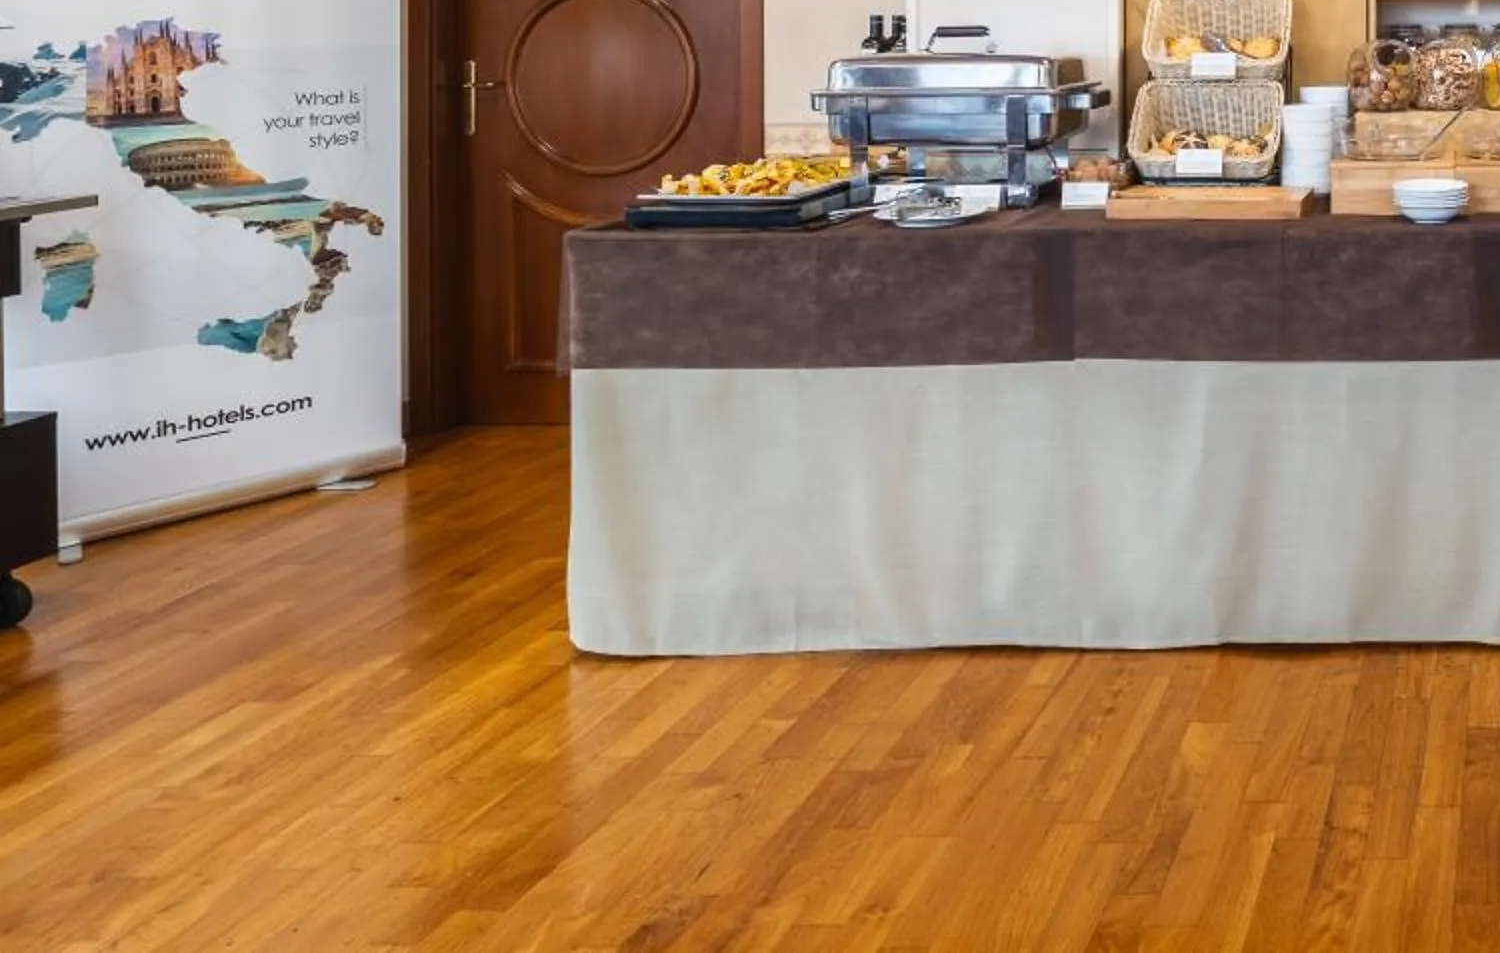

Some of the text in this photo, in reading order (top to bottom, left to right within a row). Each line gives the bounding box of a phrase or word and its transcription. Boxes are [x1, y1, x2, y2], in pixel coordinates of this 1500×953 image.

[294, 90, 360, 106] What is
[263, 110, 361, 133] your travel
[309, 130, 359, 149] style?
[85, 395, 313, 451] www.ih-hotels.com
